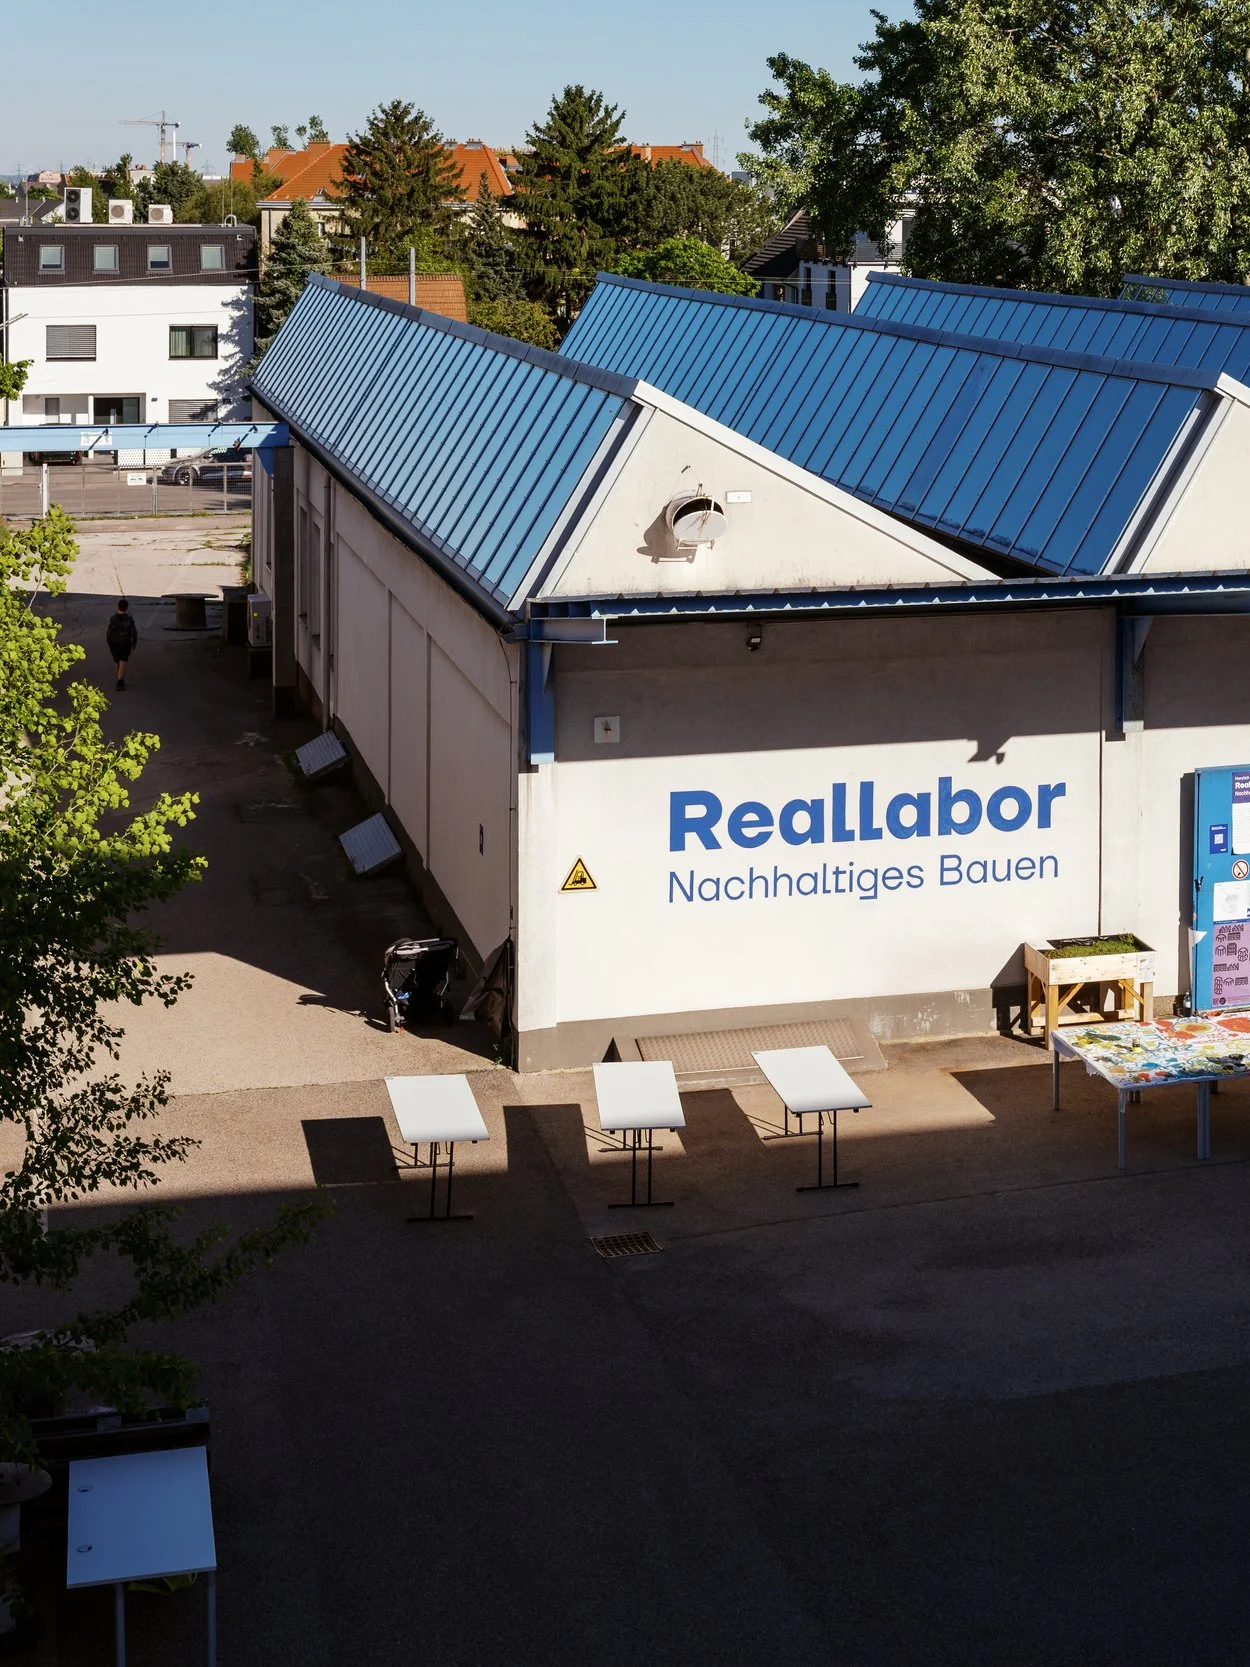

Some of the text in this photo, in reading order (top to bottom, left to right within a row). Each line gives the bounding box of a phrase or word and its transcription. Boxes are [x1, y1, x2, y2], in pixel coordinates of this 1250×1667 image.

[668, 776, 1066, 852] Reallabor
[668, 854, 1059, 903] Nachhaltiges Bauen
